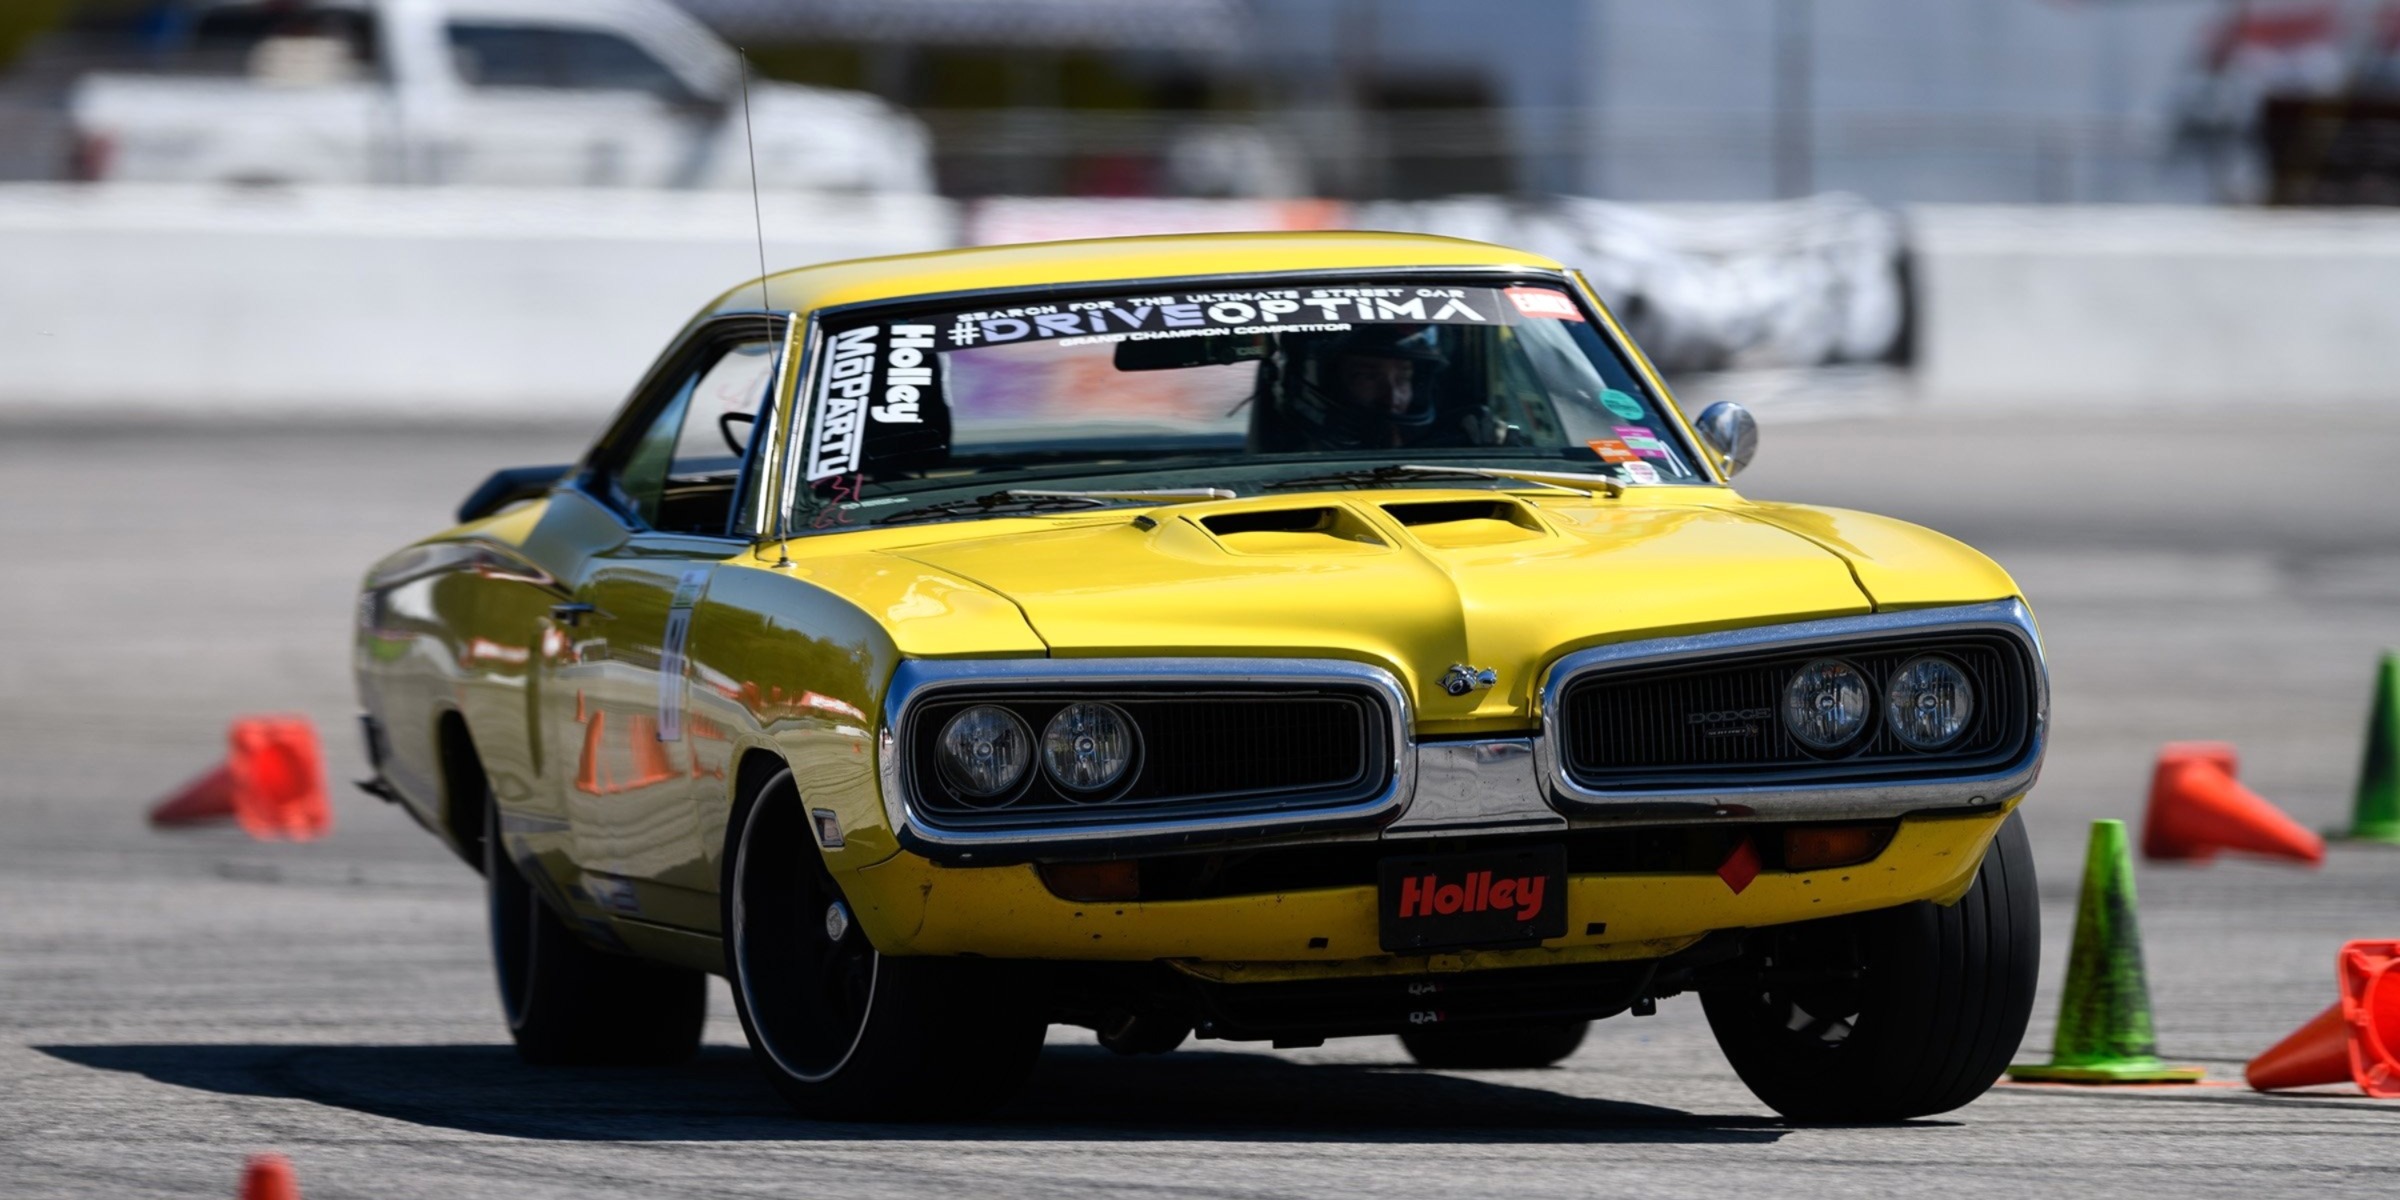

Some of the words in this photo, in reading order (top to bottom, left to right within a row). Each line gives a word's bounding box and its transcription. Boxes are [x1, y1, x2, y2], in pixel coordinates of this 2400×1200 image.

[947, 297, 1487, 346] #DRIVEOPTIMA
[956, 304, 1058, 323] SEARCH
[1068, 300, 1115, 312] FOR
[1127, 296, 1176, 307] THE
[1185, 289, 1300, 304] ULTIMATE
[1310, 287, 1404, 299] STREET
[1415, 288, 1465, 299] CAR
[1059, 334, 1126, 347] GRAND
[1129, 326, 1231, 341] CHAMPION
[1233, 322, 1352, 336] COMPETITOR
[871, 324, 936, 424] Holley
[1687, 707, 1772, 724] DODGE
[1399, 870, 1546, 922] Holley
